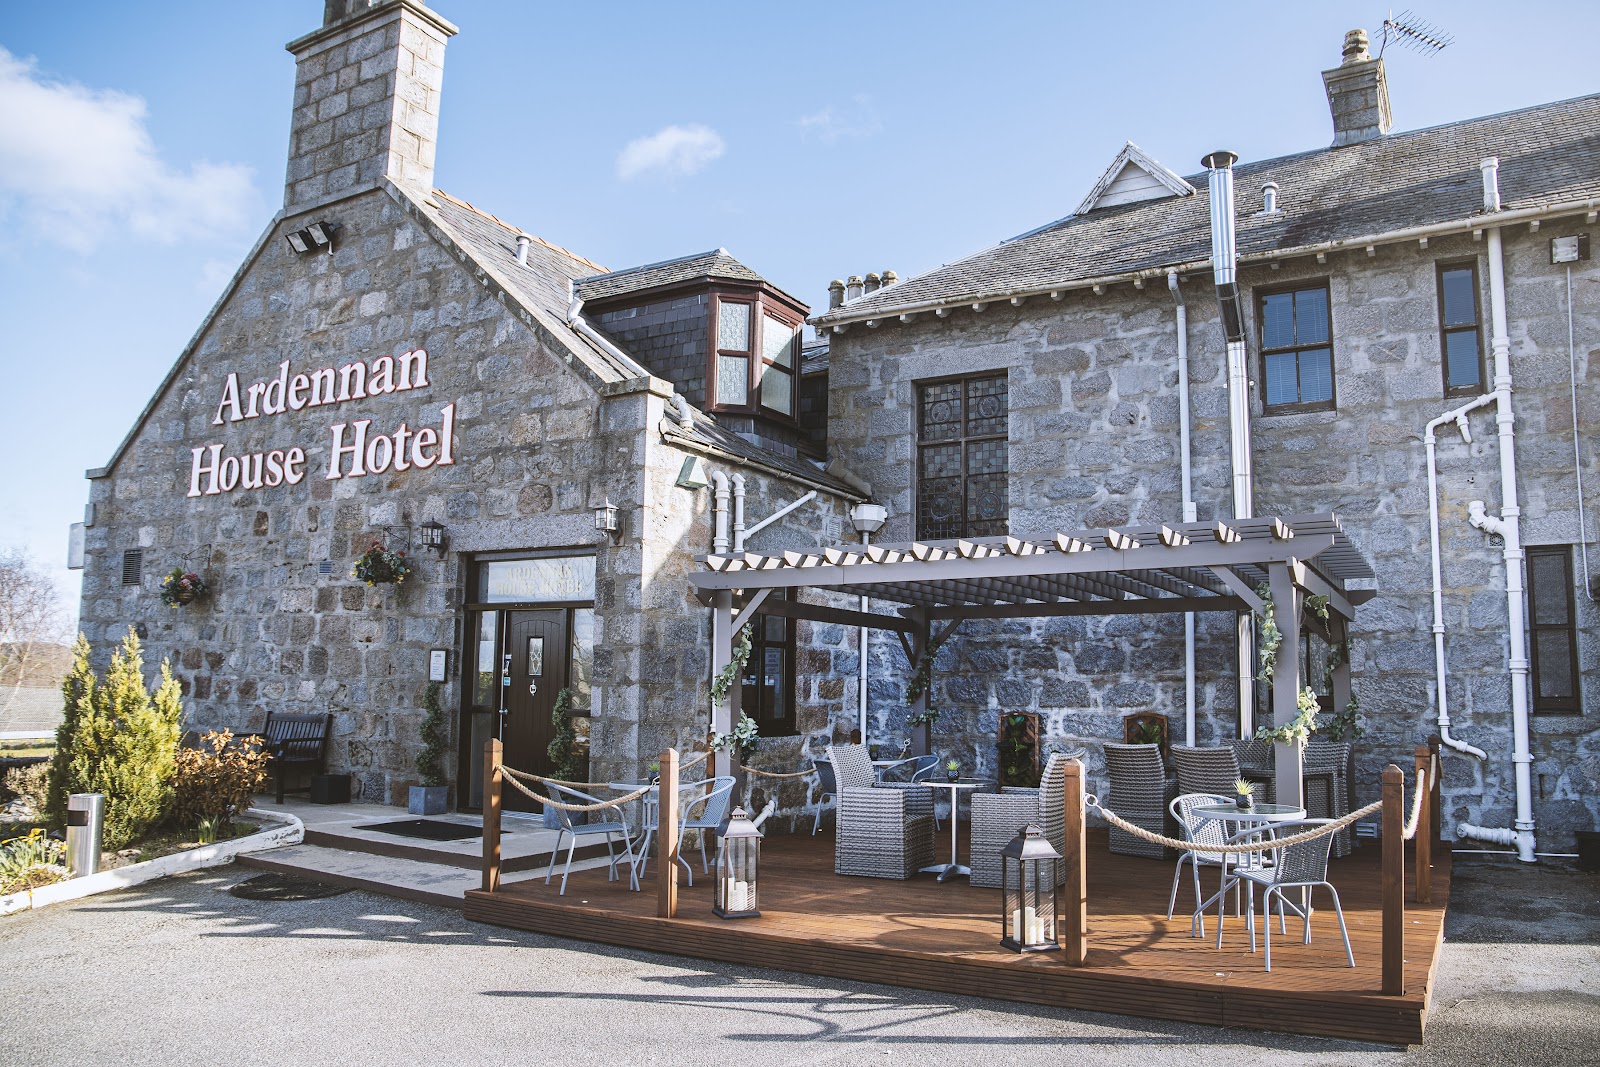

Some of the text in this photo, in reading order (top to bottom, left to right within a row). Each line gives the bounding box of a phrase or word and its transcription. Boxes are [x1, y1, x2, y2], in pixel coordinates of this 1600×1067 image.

[212, 348, 429, 425] Ardennan
[187, 403, 455, 498] House Hotel
[496, 579, 582, 596] HOUSE HOTEL
